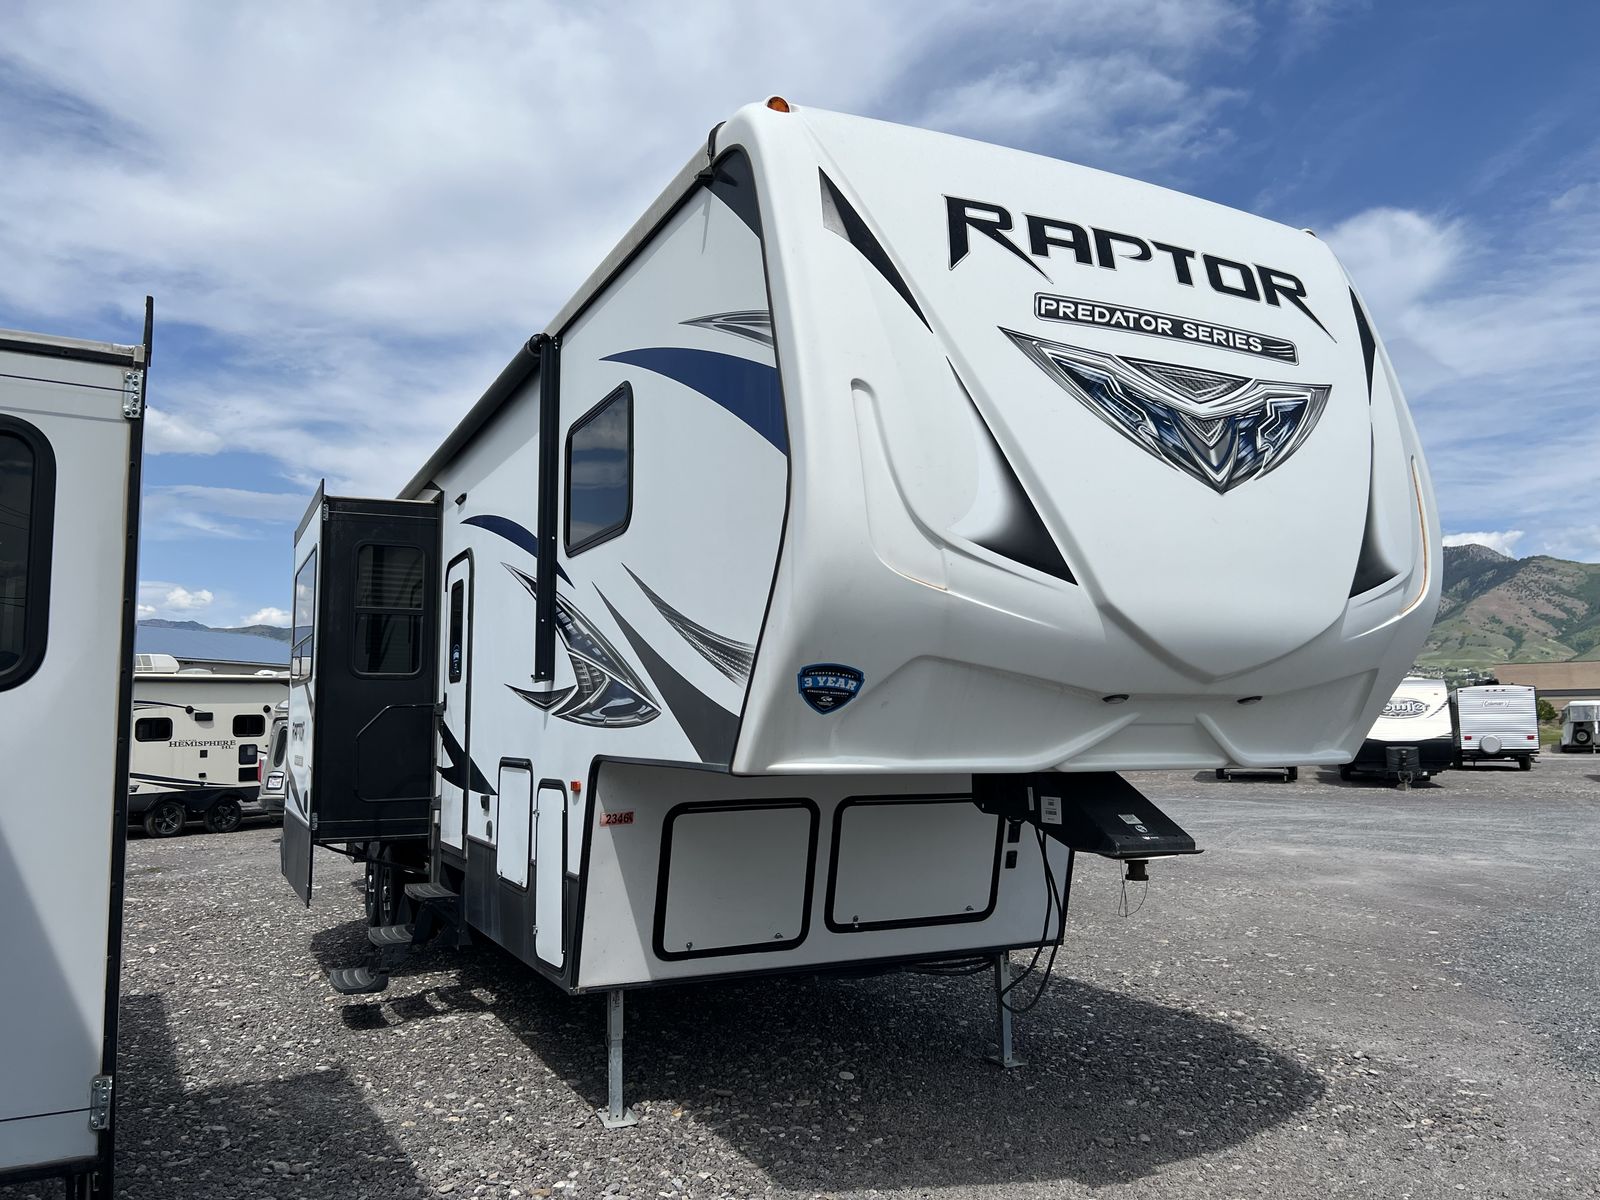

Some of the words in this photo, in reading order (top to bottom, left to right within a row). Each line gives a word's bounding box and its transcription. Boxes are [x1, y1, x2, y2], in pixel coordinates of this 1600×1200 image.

[942, 193, 1337, 343] RAPTOR
[1040, 298, 1174, 335] PREDATOR
[1182, 322, 1263, 352] SERIES
[804, 677, 812, 687] 3
[817, 676, 857, 690] YEAR
[1382, 701, 1430, 712] owler
